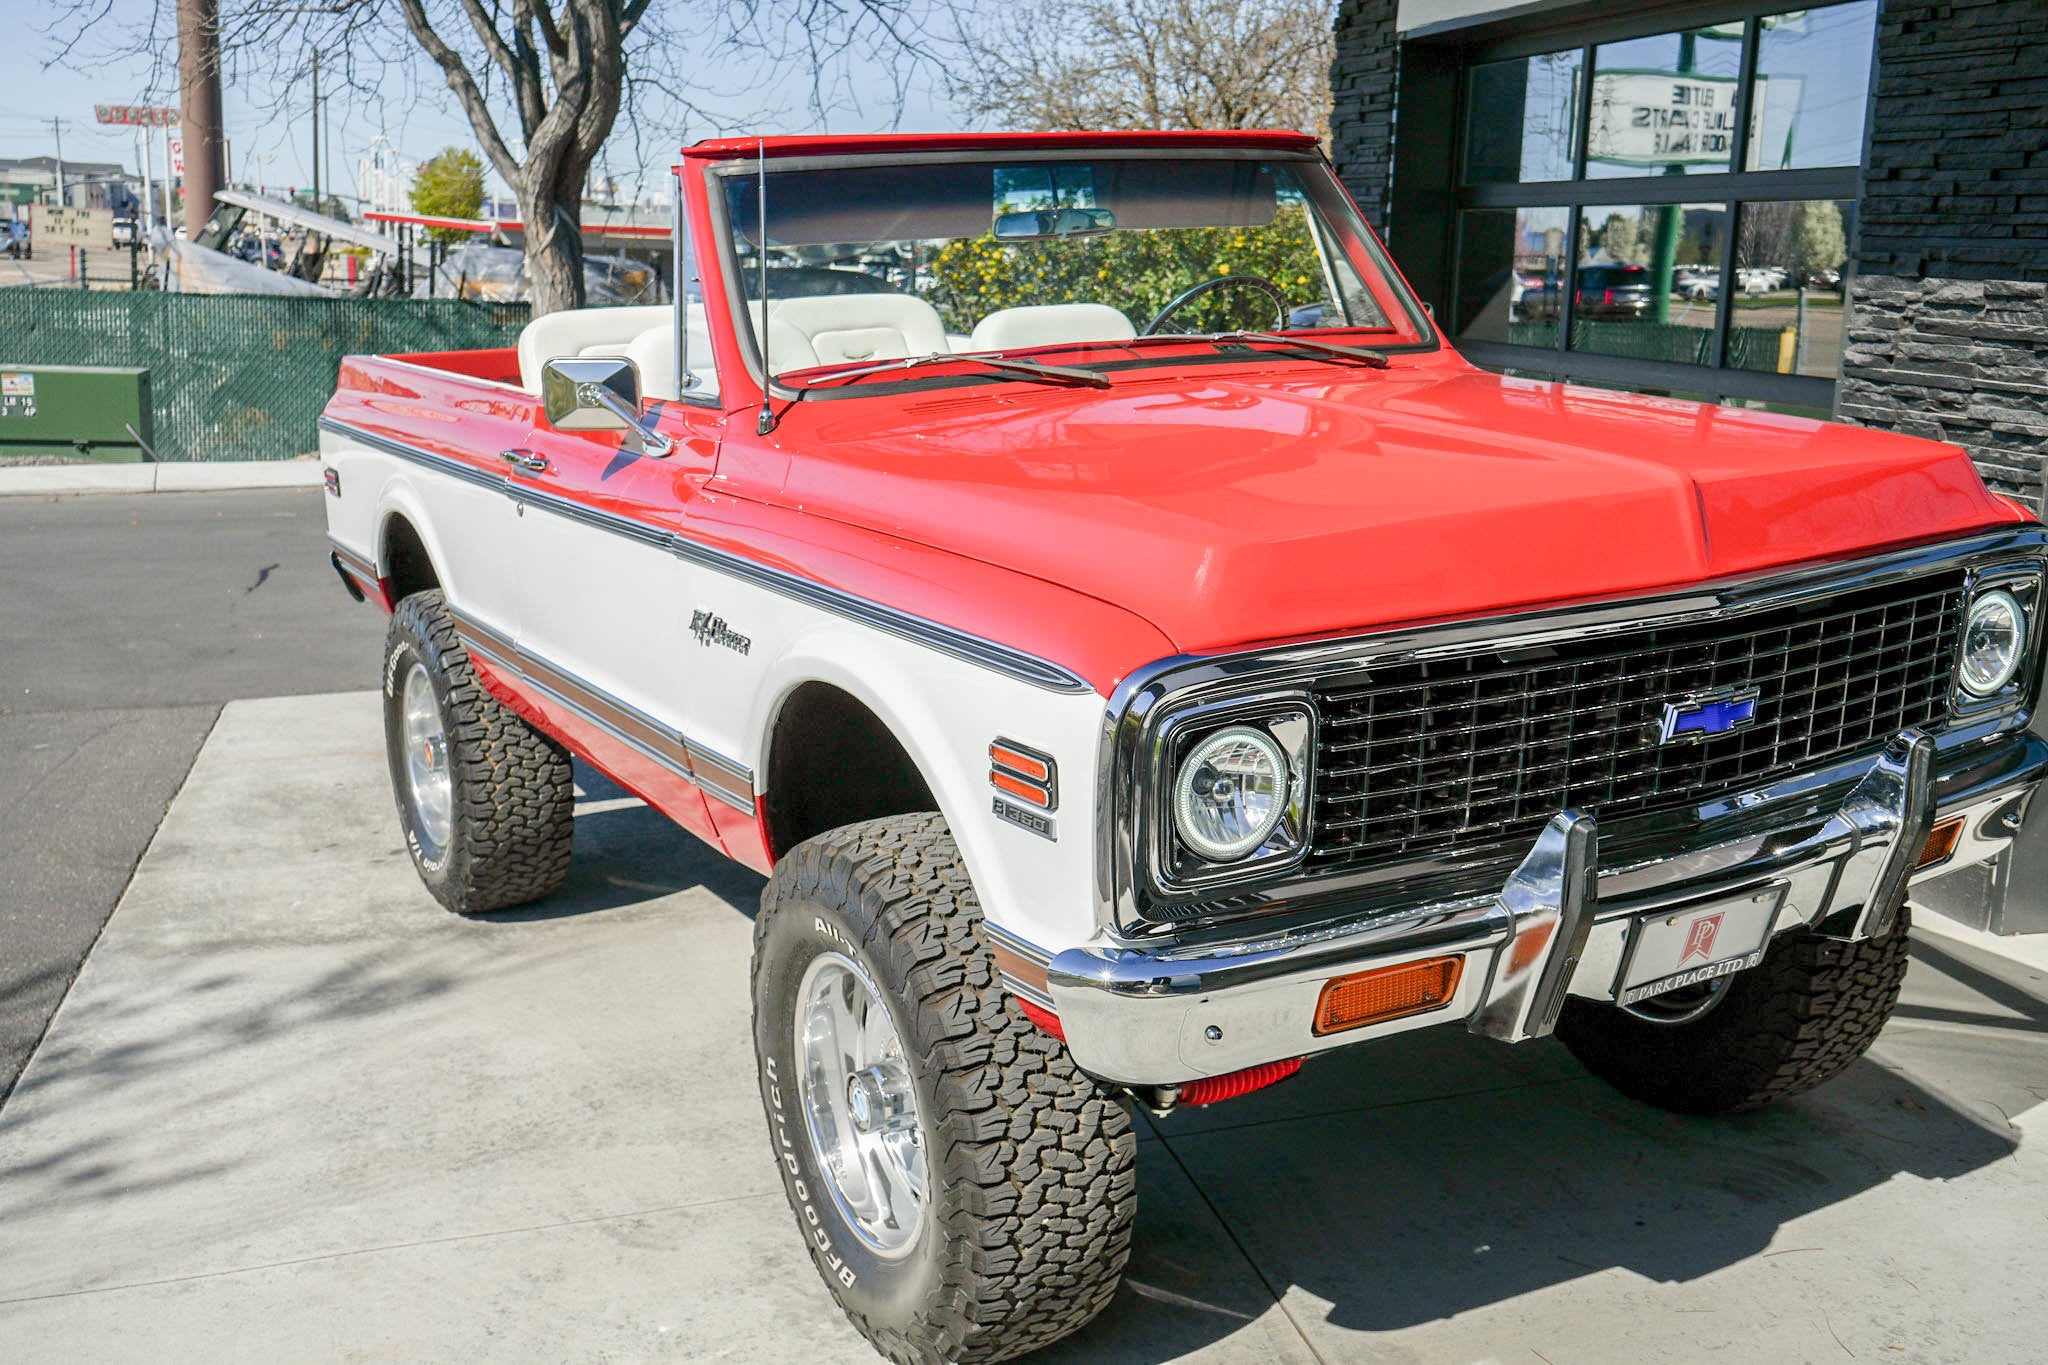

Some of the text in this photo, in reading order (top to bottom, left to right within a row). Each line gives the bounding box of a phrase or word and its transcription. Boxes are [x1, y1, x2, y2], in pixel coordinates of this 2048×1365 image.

[1008, 807, 1045, 833] 350
[1638, 979, 1674, 1000] PARK
[1674, 965, 1715, 989] PLACE
[1715, 958, 1744, 976] LTD
[766, 1055, 857, 1289] BFGoodrich
